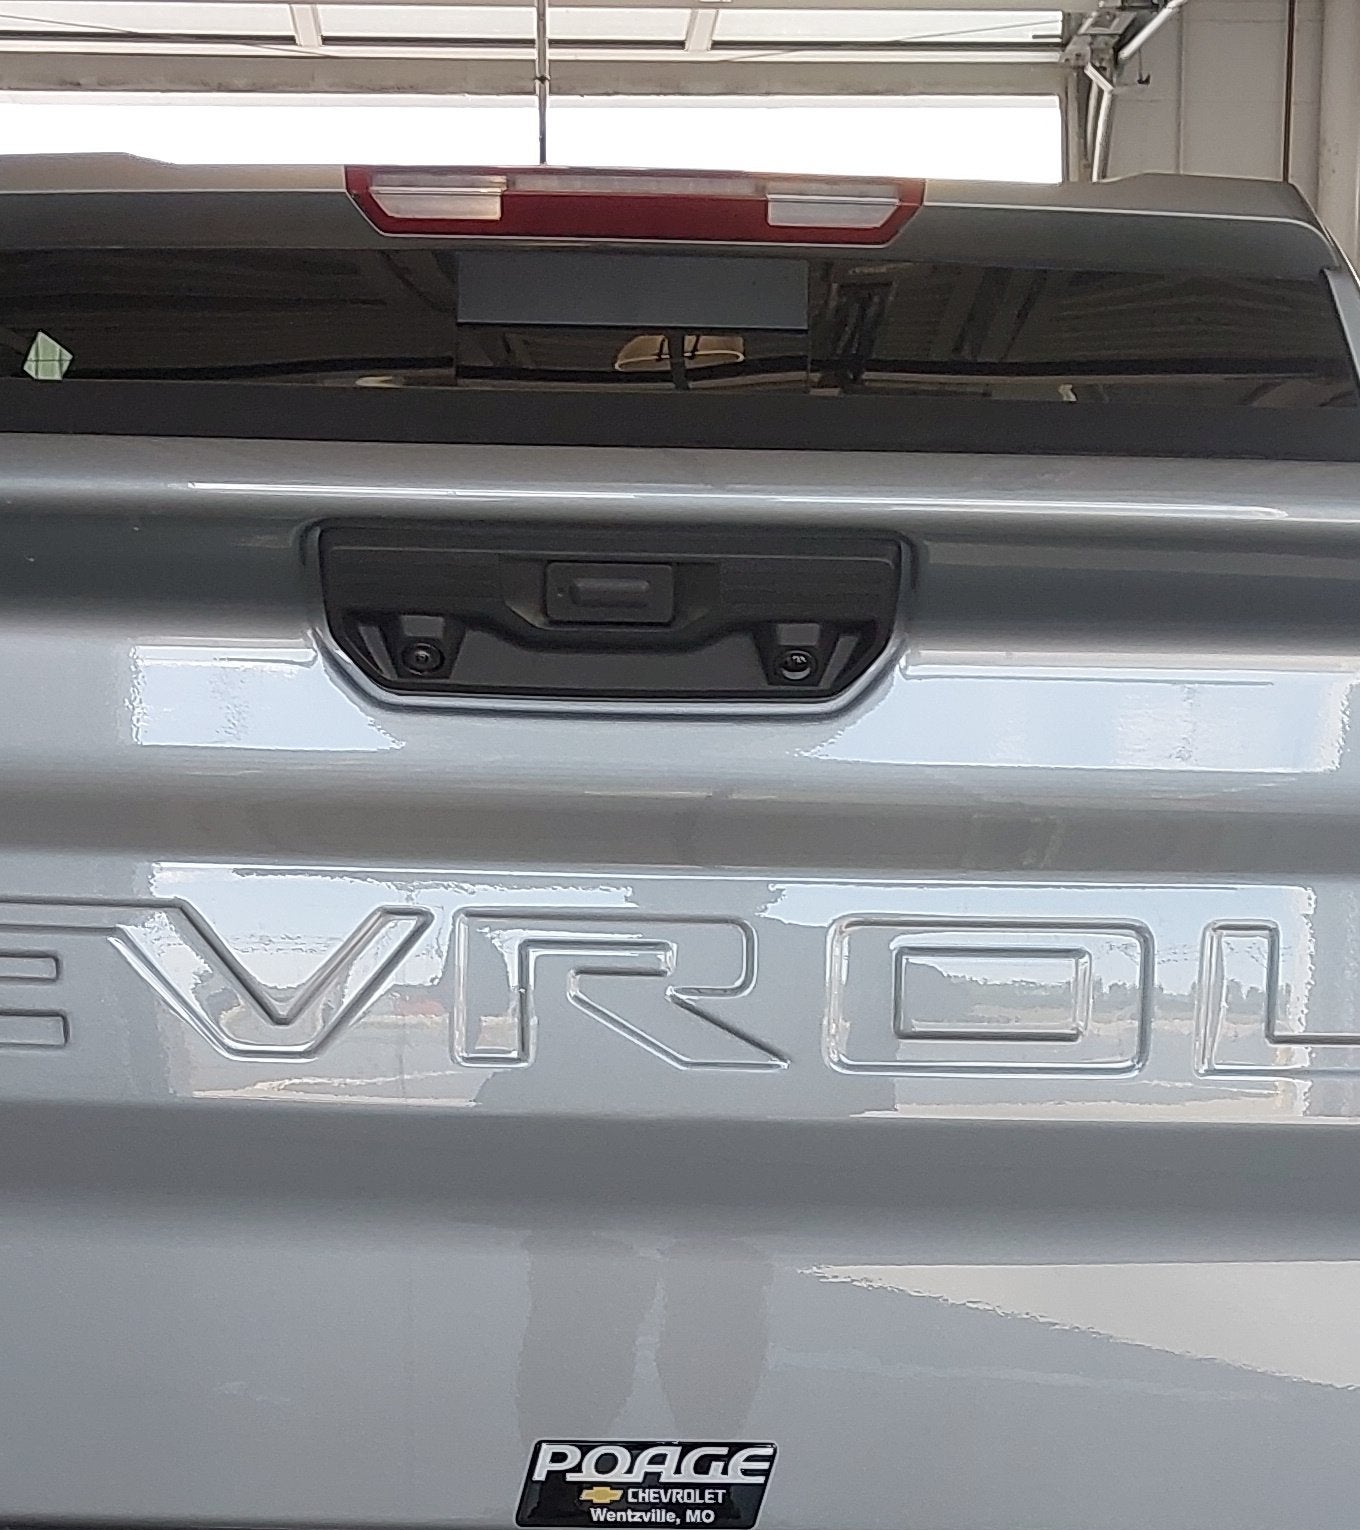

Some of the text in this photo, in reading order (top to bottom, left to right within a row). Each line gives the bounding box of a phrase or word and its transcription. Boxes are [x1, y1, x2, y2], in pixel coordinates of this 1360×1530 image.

[532, 1442, 774, 1484] POAGE
[626, 1489, 727, 1504] CHEVROLET
[589, 1507, 716, 1526] Wentzville, MO
